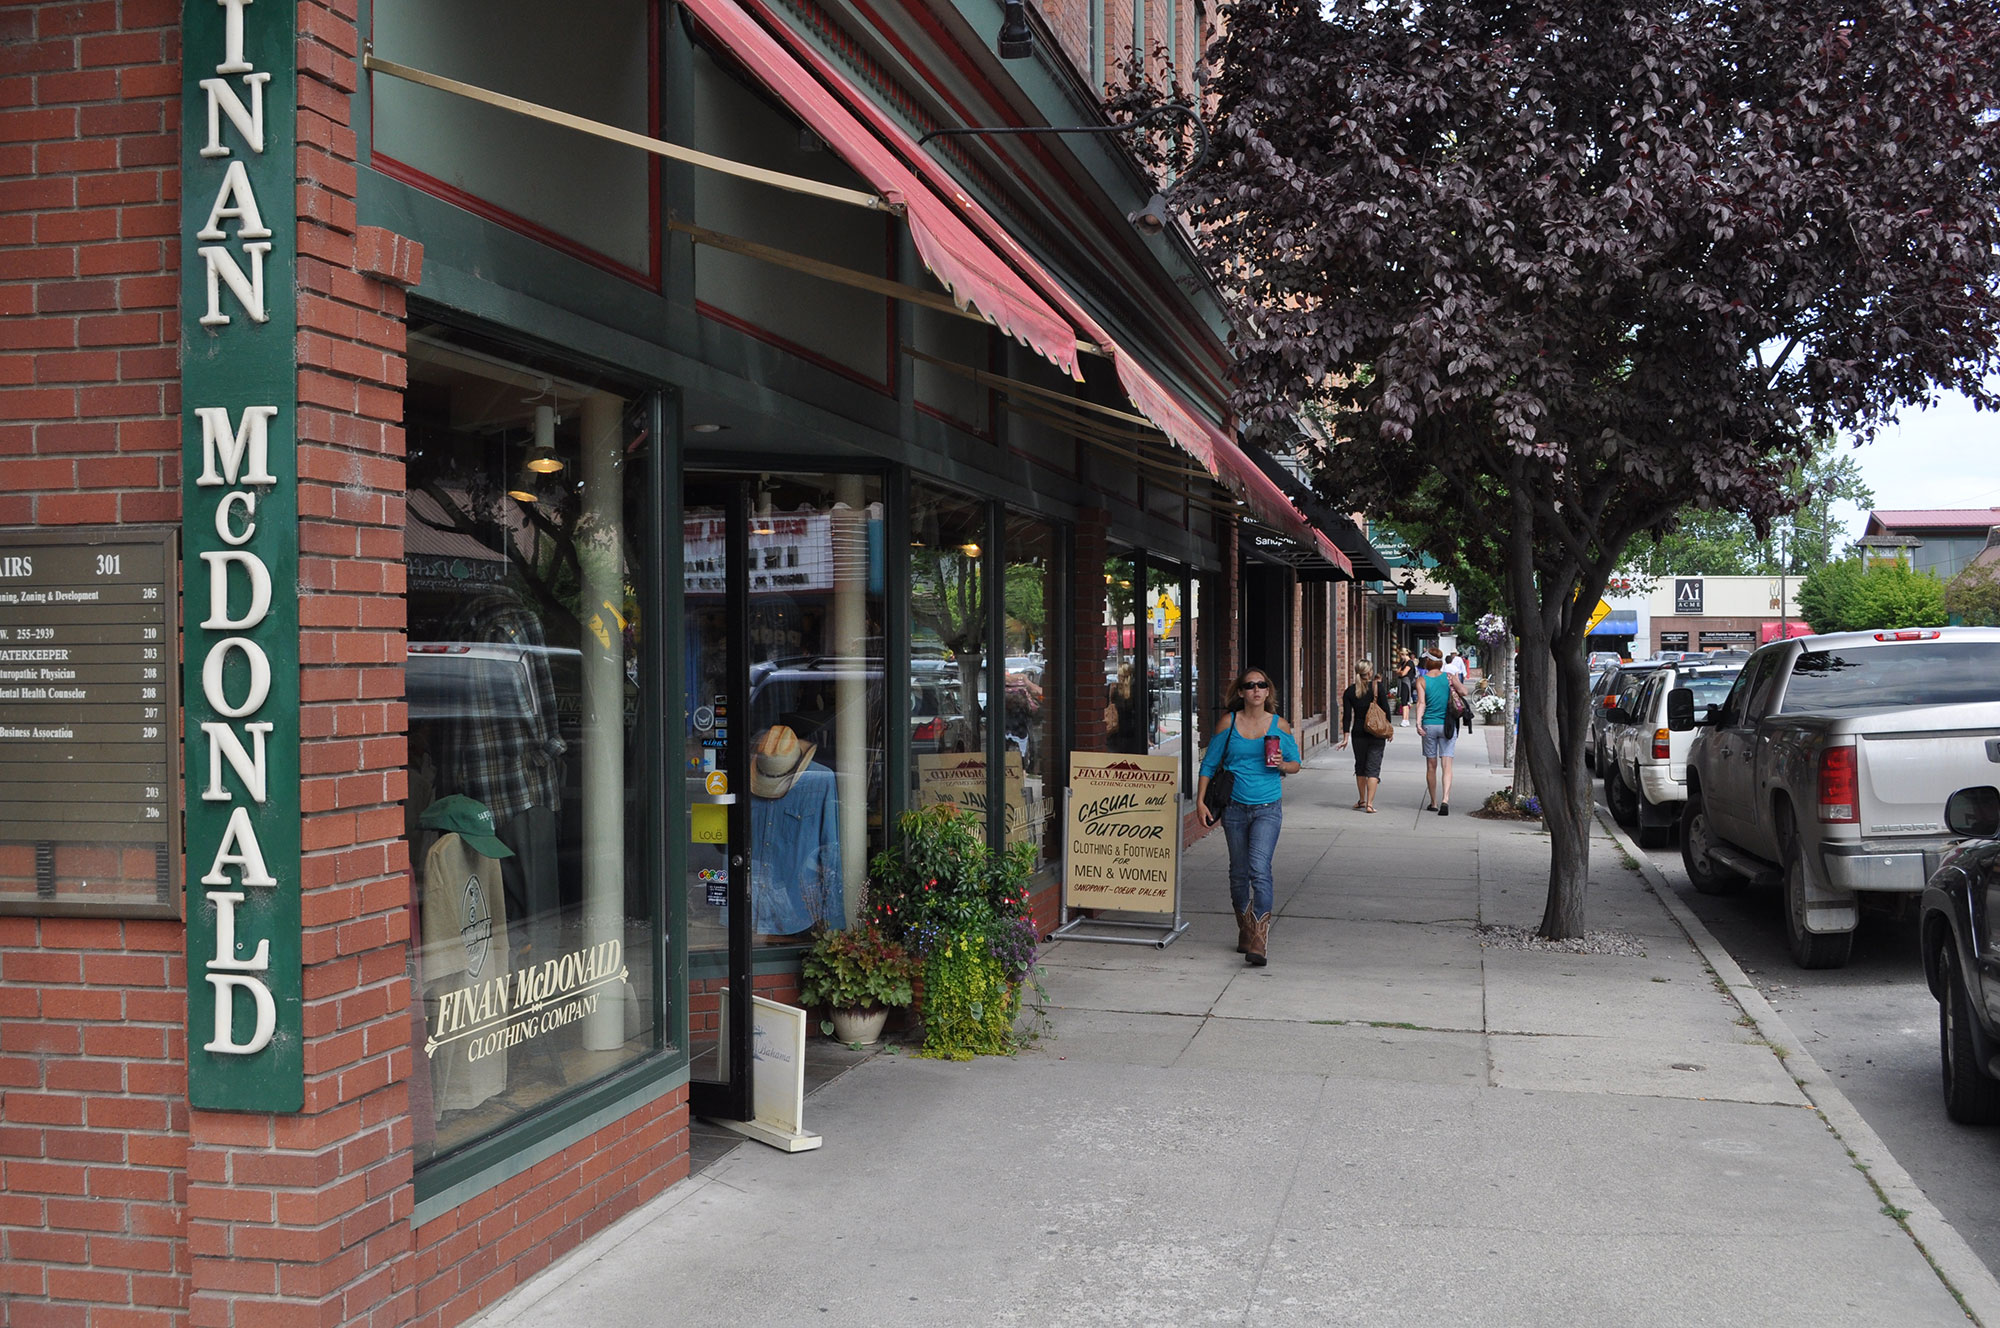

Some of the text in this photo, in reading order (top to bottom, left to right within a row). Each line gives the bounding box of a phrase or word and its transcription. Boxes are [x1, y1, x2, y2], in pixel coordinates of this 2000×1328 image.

[96, 554, 121, 575] 301
[21, 591, 46, 603] Zoning
[48, 590, 53, 601] &
[55, 590, 99, 602] Development
[143, 588, 157, 599] 205
[144, 628, 157, 639] 210
[144, 648, 157, 659] 203
[41, 669, 76, 680] Physician
[144, 668, 157, 679] 208
[22, 688, 46, 699] Health
[48, 688, 87, 699] Counselor
[143, 688, 156, 698] 208
[145, 708, 158, 718] 207
[0, 727, 157, 739] Business Assocation 209
[1077, 768, 1170, 783] FINAN McDONALD
[146, 787, 159, 798] 203
[146, 807, 159, 818] 206
[1078, 793, 1168, 822] CASUAL and
[1085, 822, 1164, 840] OUTDOOR
[1115, 846, 1121, 857] &
[1112, 857, 1131, 865] FOR
[1074, 864, 1168, 882] MEN & WOMEN
[1138, 888, 1168, 898] D'ALENE
[434, 938, 621, 1038] FINAN McDONALD
[467, 992, 600, 1063] CLOTHING COMPANY
[758, 1045, 791, 1063] Bahama
